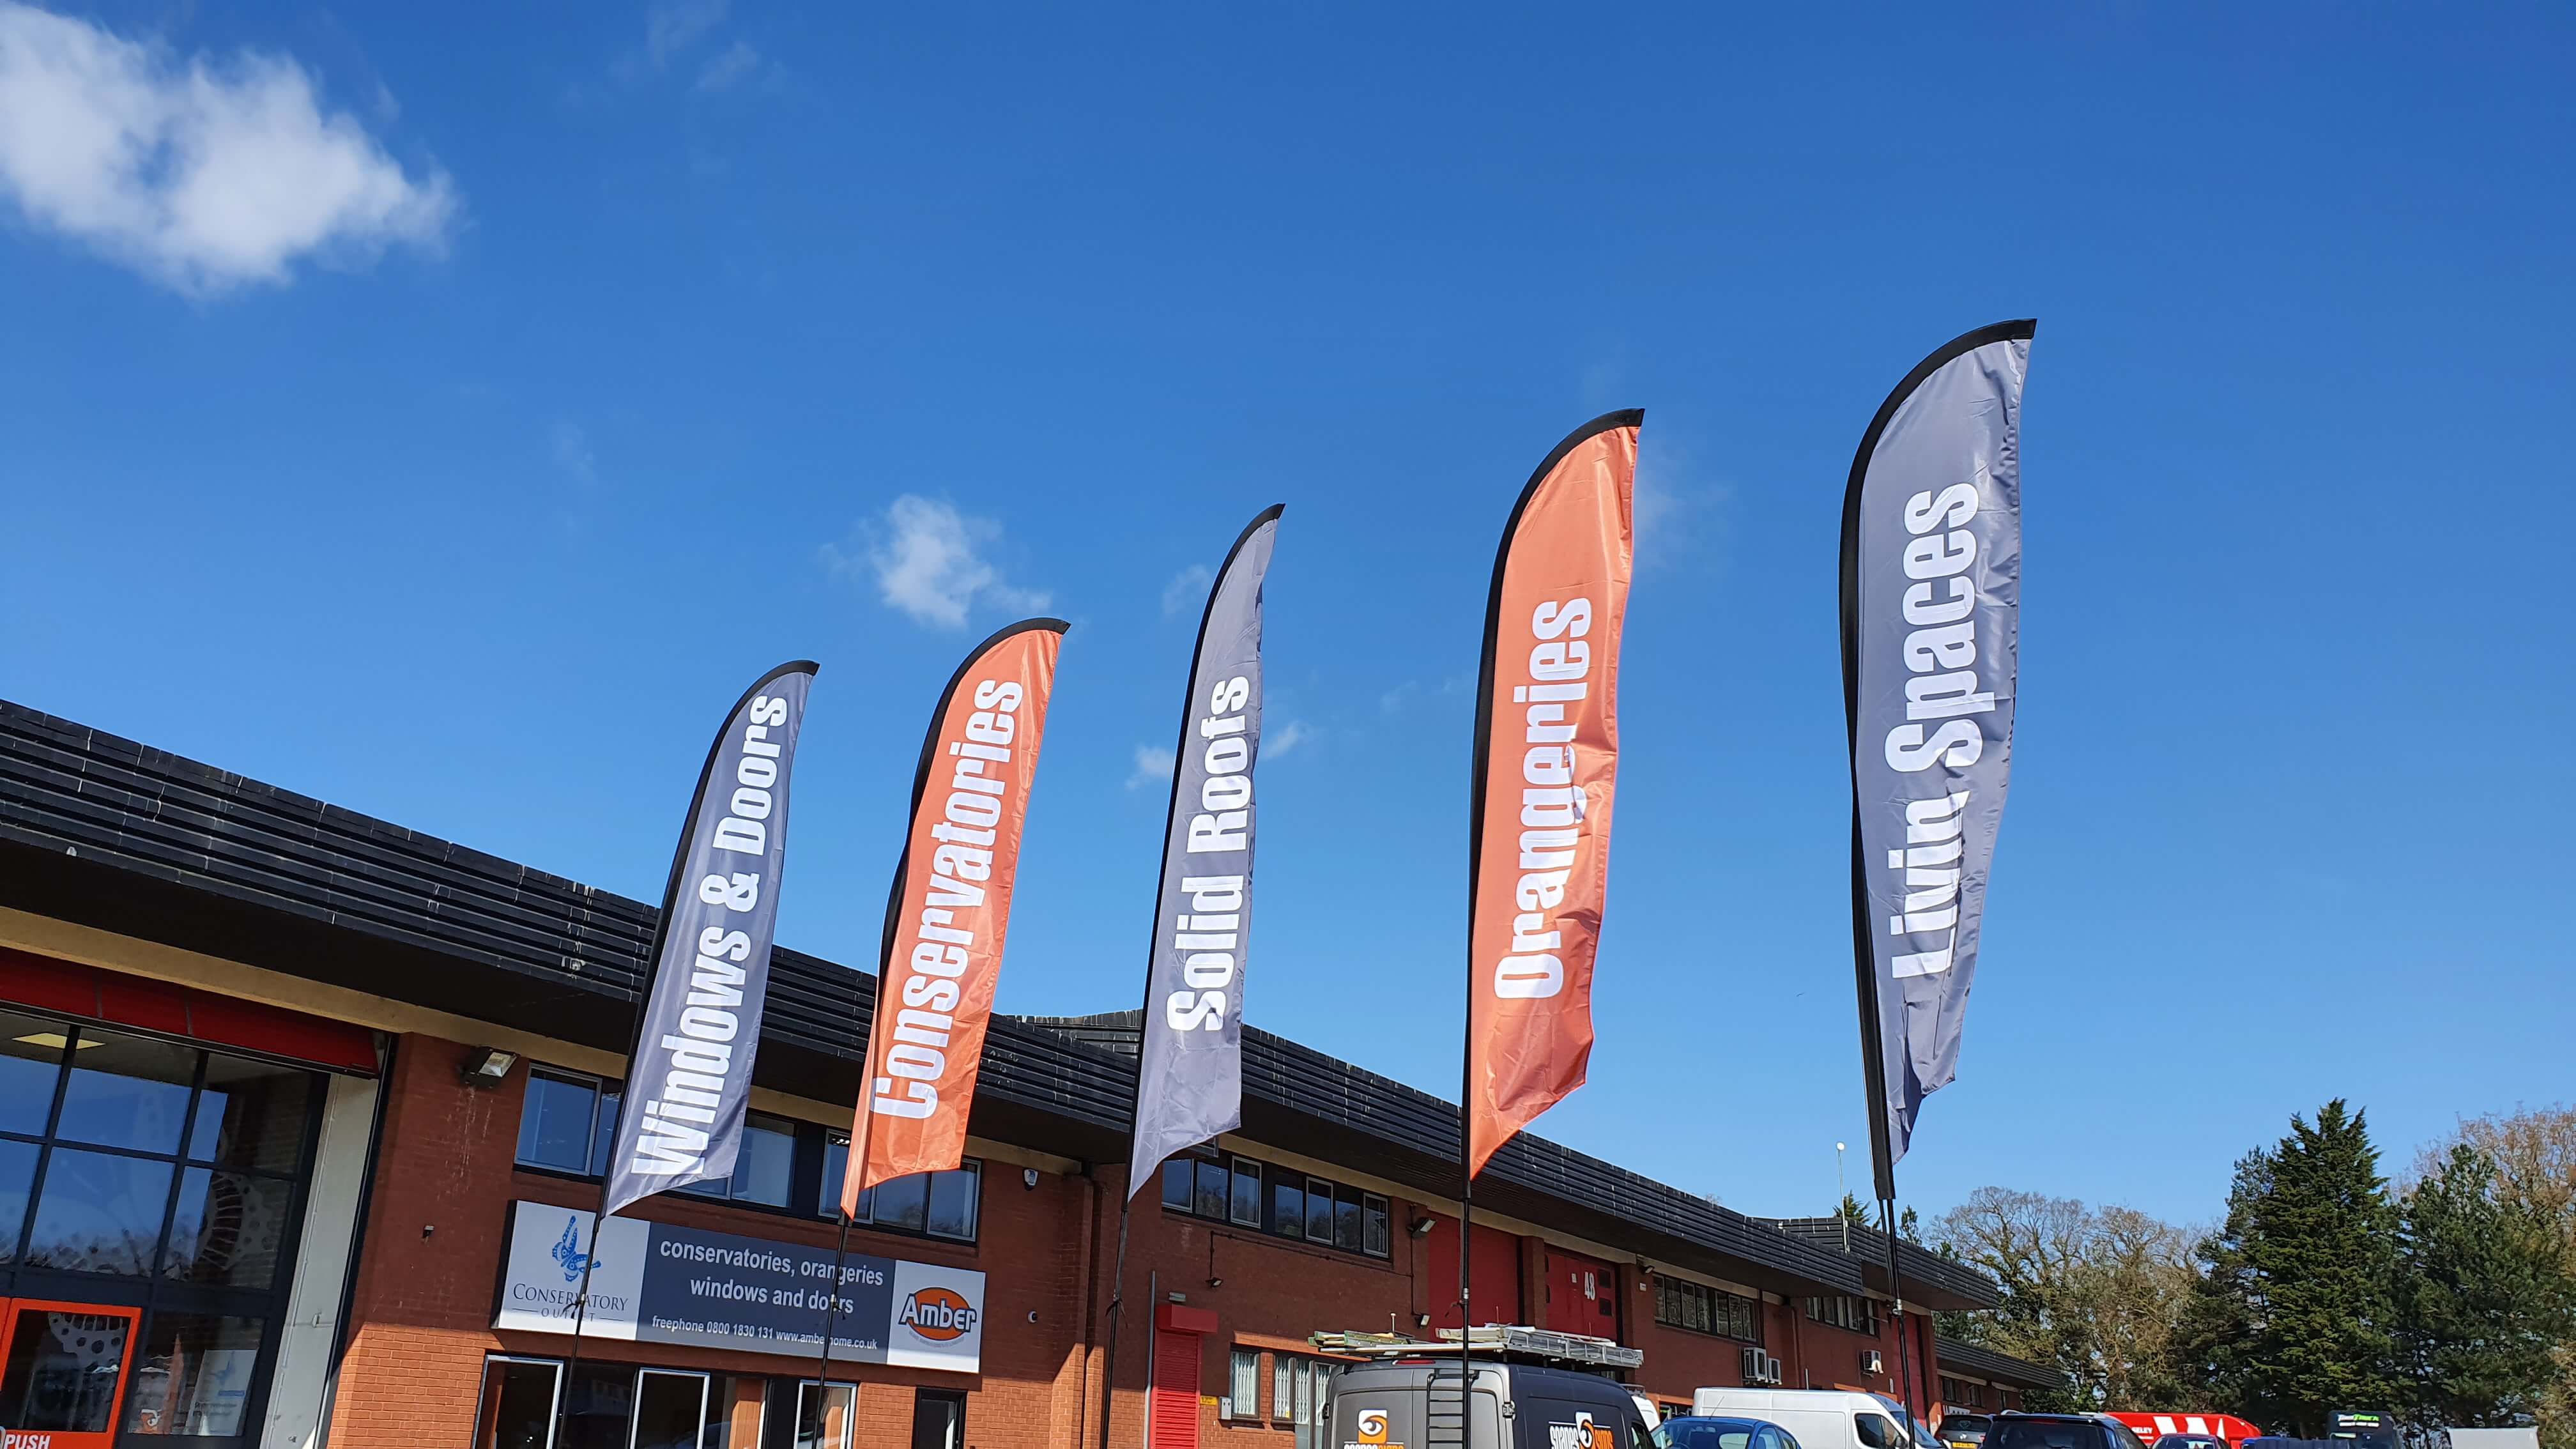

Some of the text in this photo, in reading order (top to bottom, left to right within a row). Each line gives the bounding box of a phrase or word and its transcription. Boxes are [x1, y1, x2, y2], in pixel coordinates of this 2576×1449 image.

[1885, 482, 1995, 772] Spaces
[1494, 597, 1592, 999] Orangeries
[1167, 676, 1251, 1031] Solid Roofs
[870, 680, 1023, 1119] Conservatories
[631, 695, 787, 1174] Windows & Doors
[660, 1241, 884, 1285] conservatories, orangeries
[691, 1276, 854, 1314] windows and dors
[1584, 1271, 1595, 1301] 48
[541, 1308, 595, 1322] OUTT
[652, 1315, 877, 1350] freephone 0800 1830 131 www.ambeome.co.uk
[898, 1293, 977, 1333] Amber
[3, 1434, 51, 1449] PUSH
